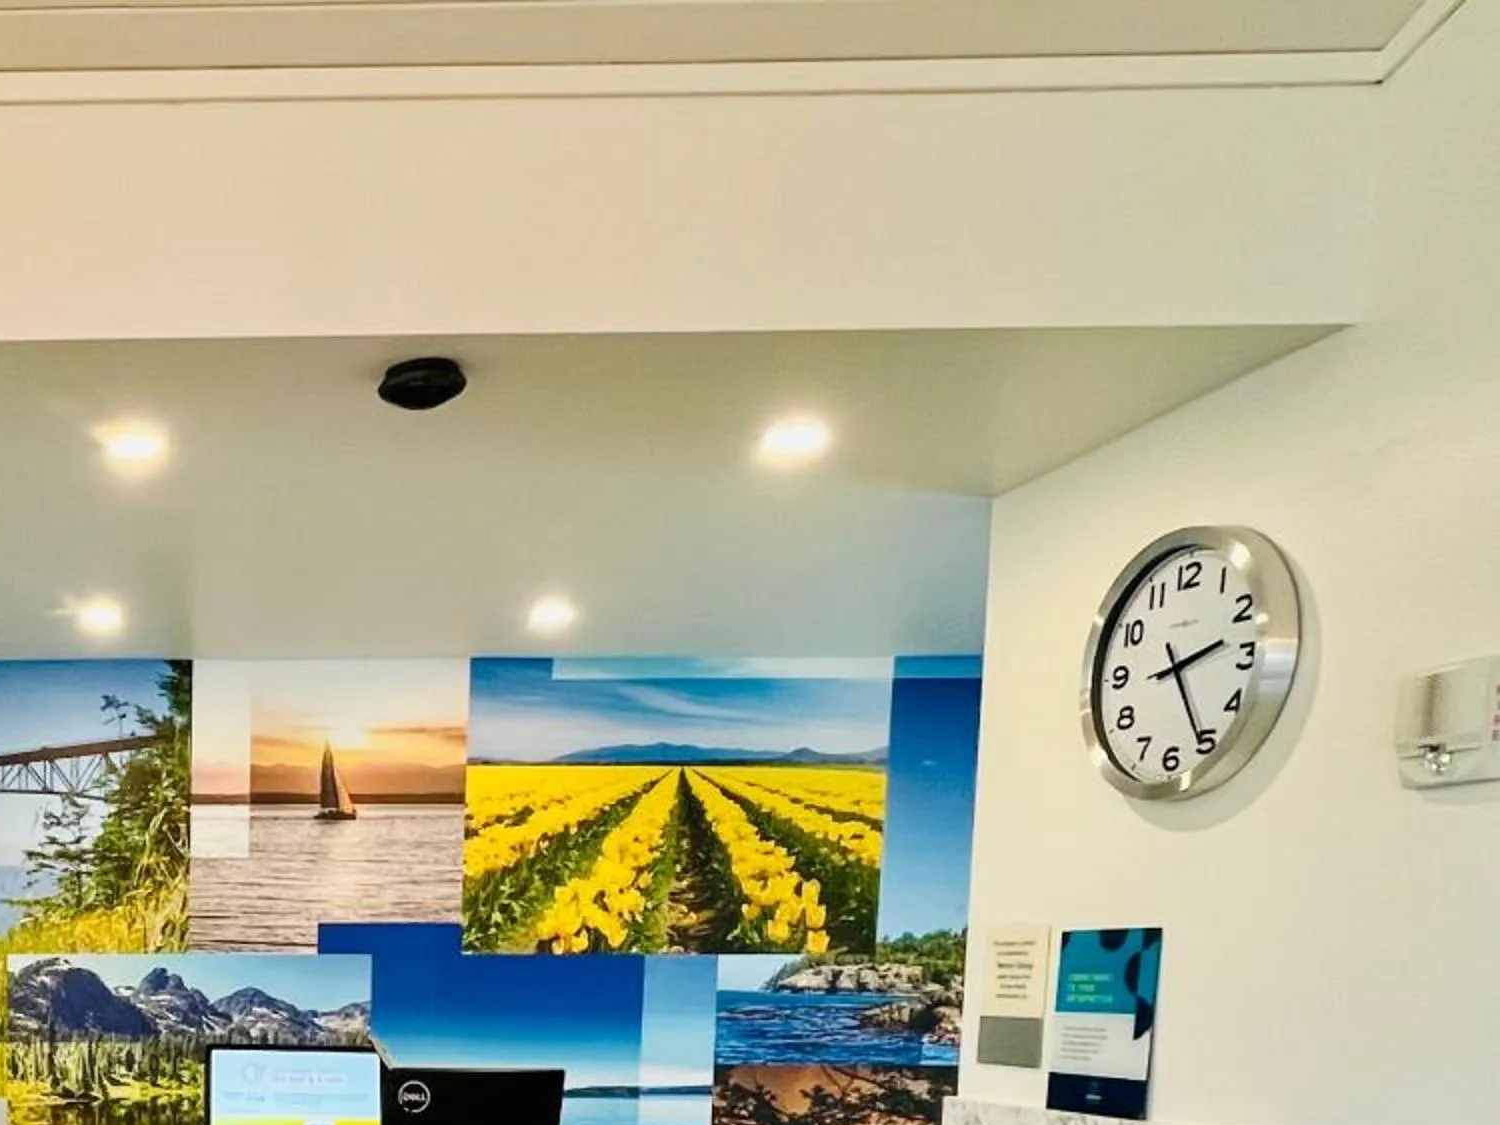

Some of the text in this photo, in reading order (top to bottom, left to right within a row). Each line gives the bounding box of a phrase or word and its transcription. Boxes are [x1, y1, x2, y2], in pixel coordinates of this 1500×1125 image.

[1177, 562, 1202, 591] 12
[1219, 567, 1227, 593] 1
[1149, 582, 1166, 610] 11
[1232, 594, 1253, 623] 2
[1123, 620, 1144, 647] 10
[1236, 642, 1255, 670] 3
[1111, 665, 1129, 689] 9
[1223, 689, 1242, 713] 4
[1116, 706, 1135, 730] 8
[1136, 736, 1152, 761] 7
[1195, 729, 1216, 754] 5
[1162, 747, 1180, 771] 6
